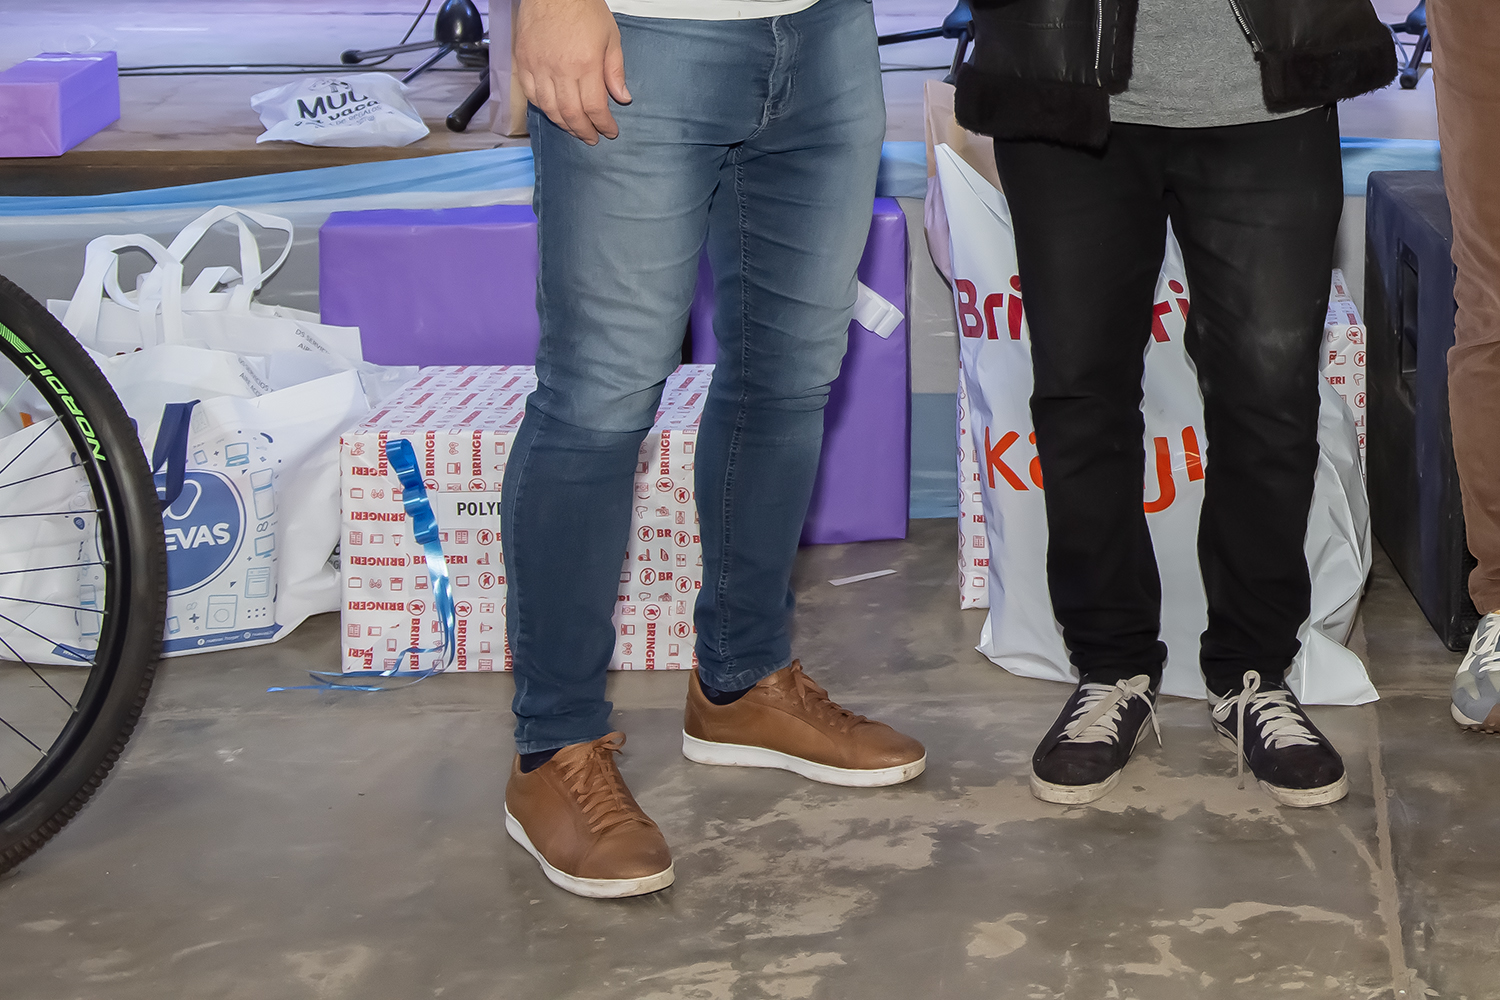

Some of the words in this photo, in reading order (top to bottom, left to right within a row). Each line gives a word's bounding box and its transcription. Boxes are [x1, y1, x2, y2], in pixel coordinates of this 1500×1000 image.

[954, 275, 1190, 343] Briri
[25, 353, 106, 461] NORDIC
[352, 466, 377, 476] GERI
[350, 511, 406, 522] BRINGERI
[164, 523, 231, 551] EVAS
[350, 555, 405, 566] BRINGERI
[413, 555, 468, 565] BRGERI
[348, 601, 405, 611] BRINGERI
[410, 618, 420, 670] BRINERI
[457, 620, 467, 670] BRINGERI
[646, 622, 656, 670] BRINGER
